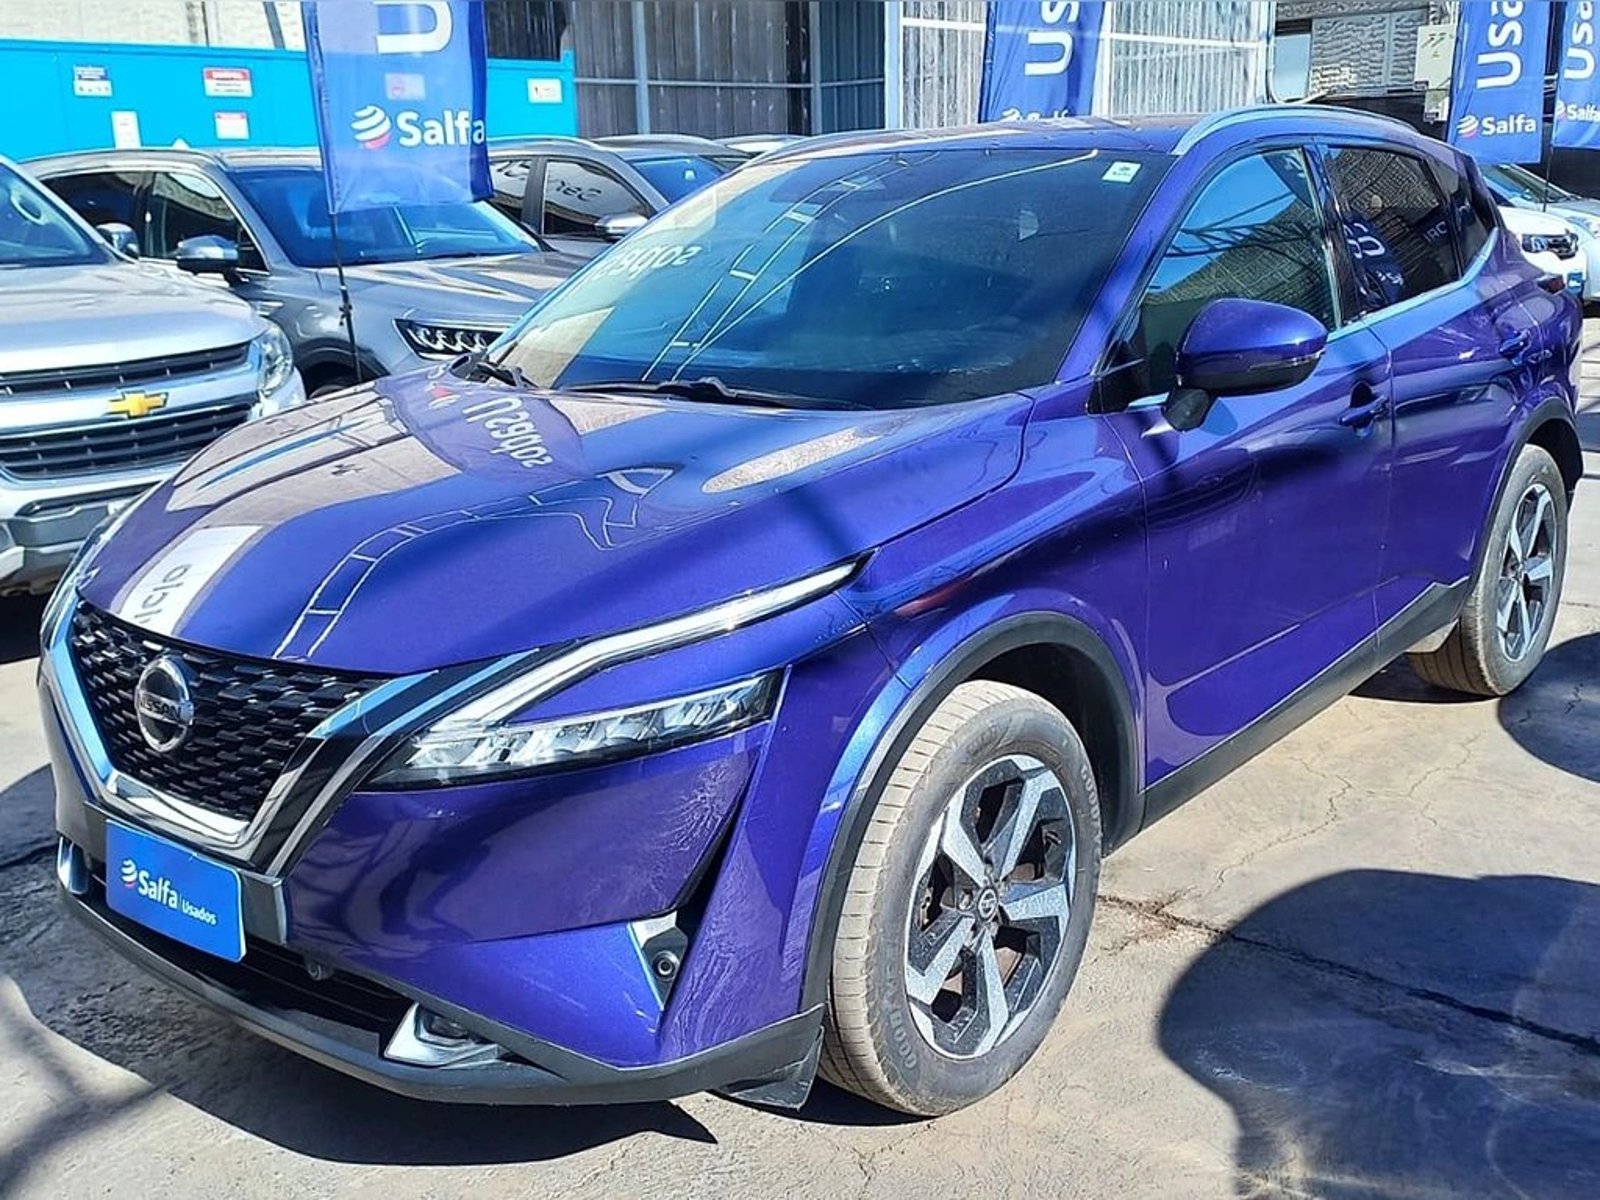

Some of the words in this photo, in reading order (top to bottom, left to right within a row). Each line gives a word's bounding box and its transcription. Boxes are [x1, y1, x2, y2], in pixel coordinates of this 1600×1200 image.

[397, 109, 485, 147] Salfa
[1481, 113, 1537, 136] Salfa
[138, 869, 178, 909] Salfa
[182, 898, 217, 926] Usados
